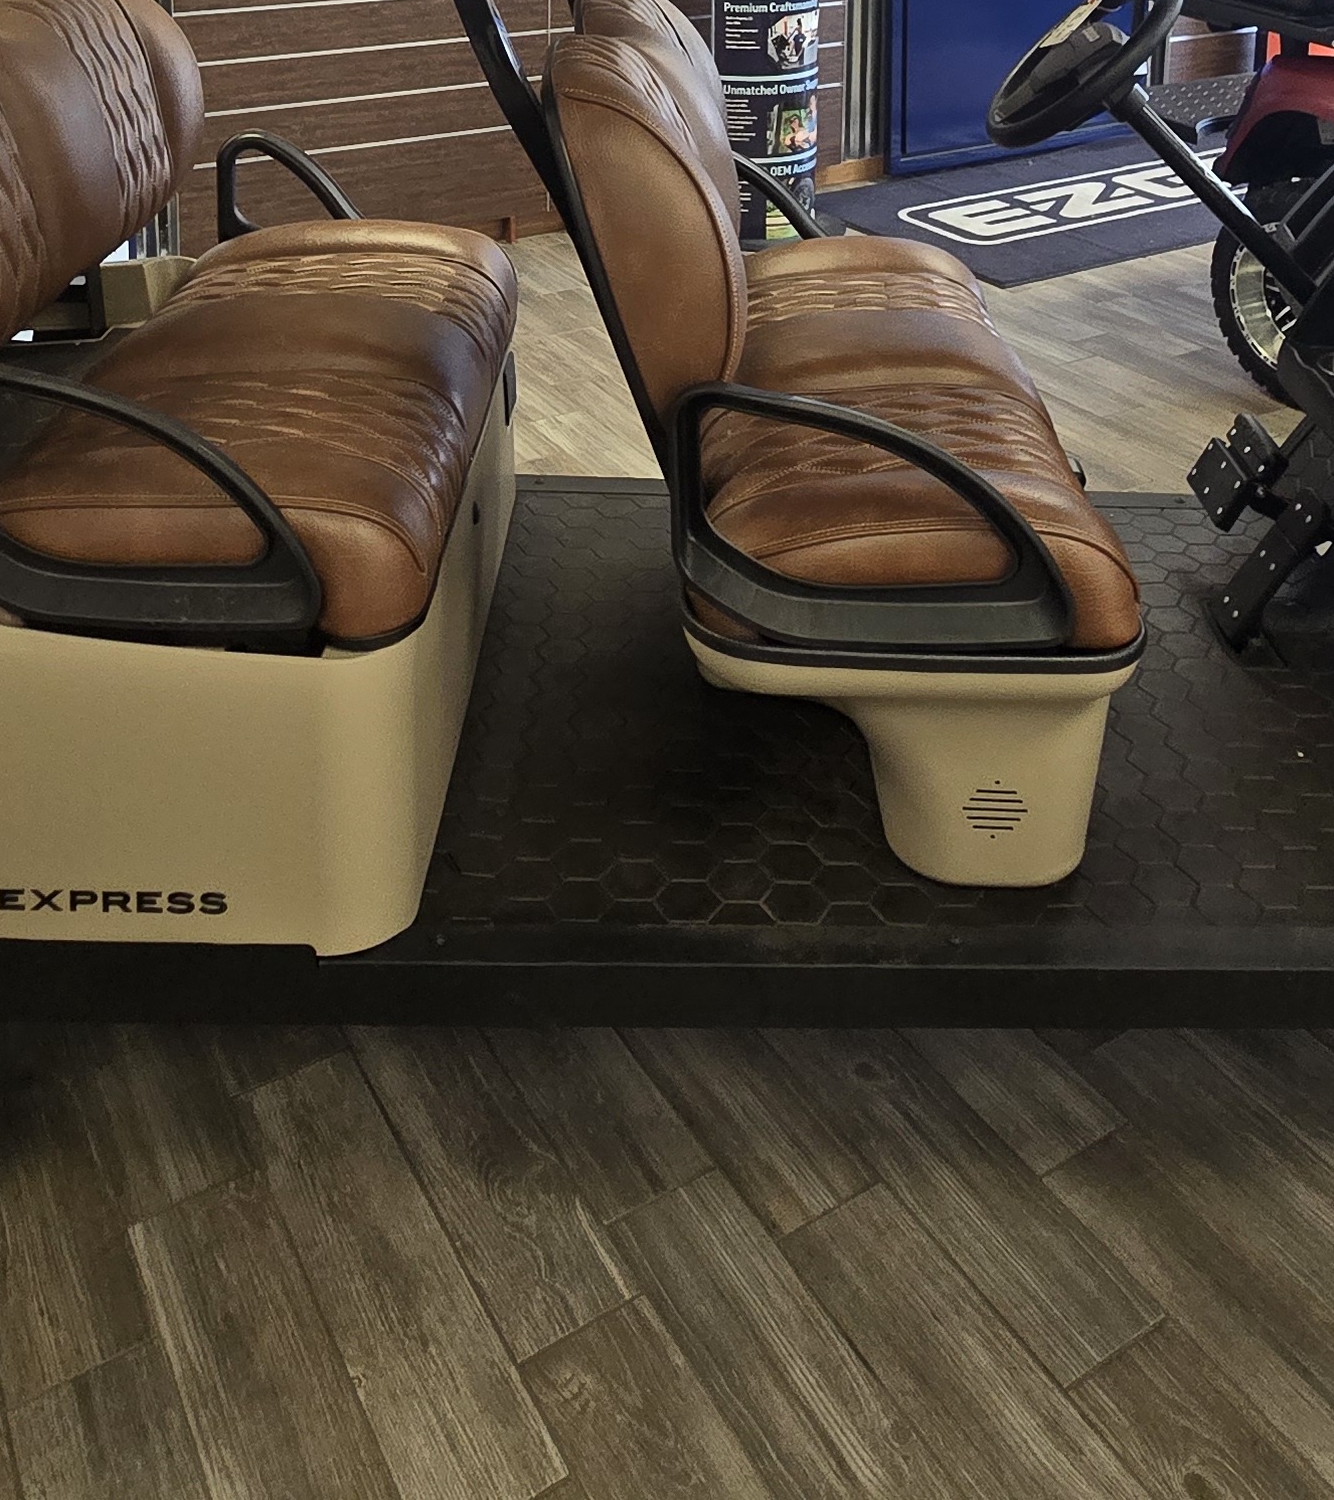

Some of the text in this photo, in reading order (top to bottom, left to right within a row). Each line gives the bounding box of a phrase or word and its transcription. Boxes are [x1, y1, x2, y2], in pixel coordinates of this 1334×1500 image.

[724, 1, 767, 13] Premium
[723, 84, 778, 96] Unmatched
[770, 164, 791, 176] OEM
